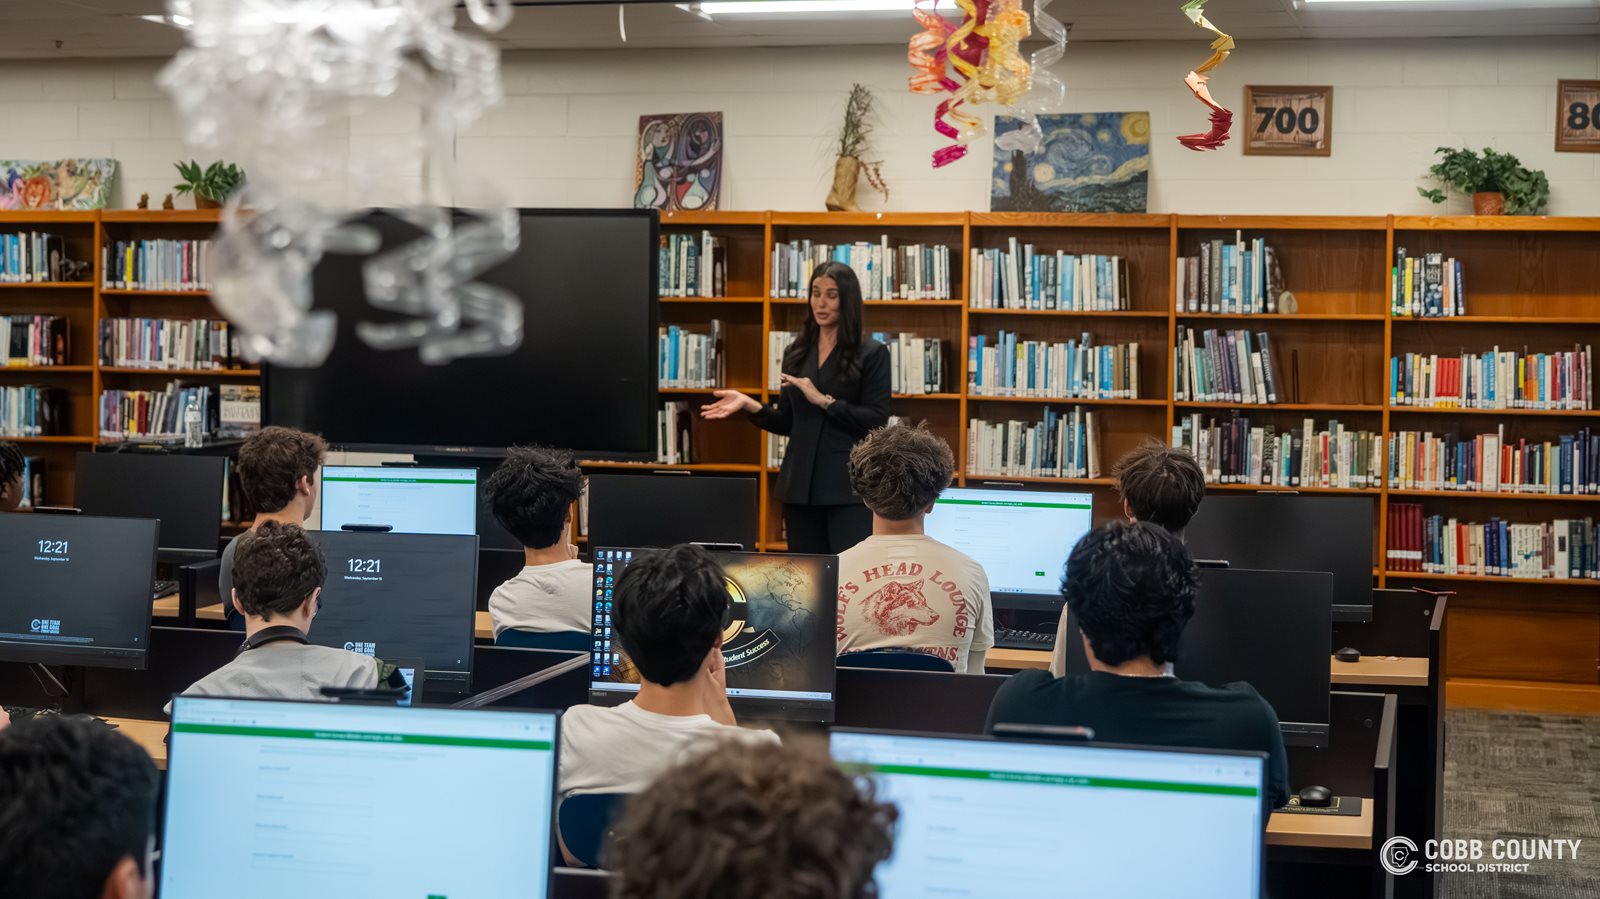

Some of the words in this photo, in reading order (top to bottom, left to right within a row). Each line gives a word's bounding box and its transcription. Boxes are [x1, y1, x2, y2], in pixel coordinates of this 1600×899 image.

[1255, 106, 1319, 134] 700
[38, 540, 69, 554] 12:21
[348, 558, 381, 573] 12:21
[862, 562, 924, 583] HEAD
[929, 569, 969, 638] LOUNGE
[723, 650, 746, 664] tudent
[745, 638, 771, 656] Success
